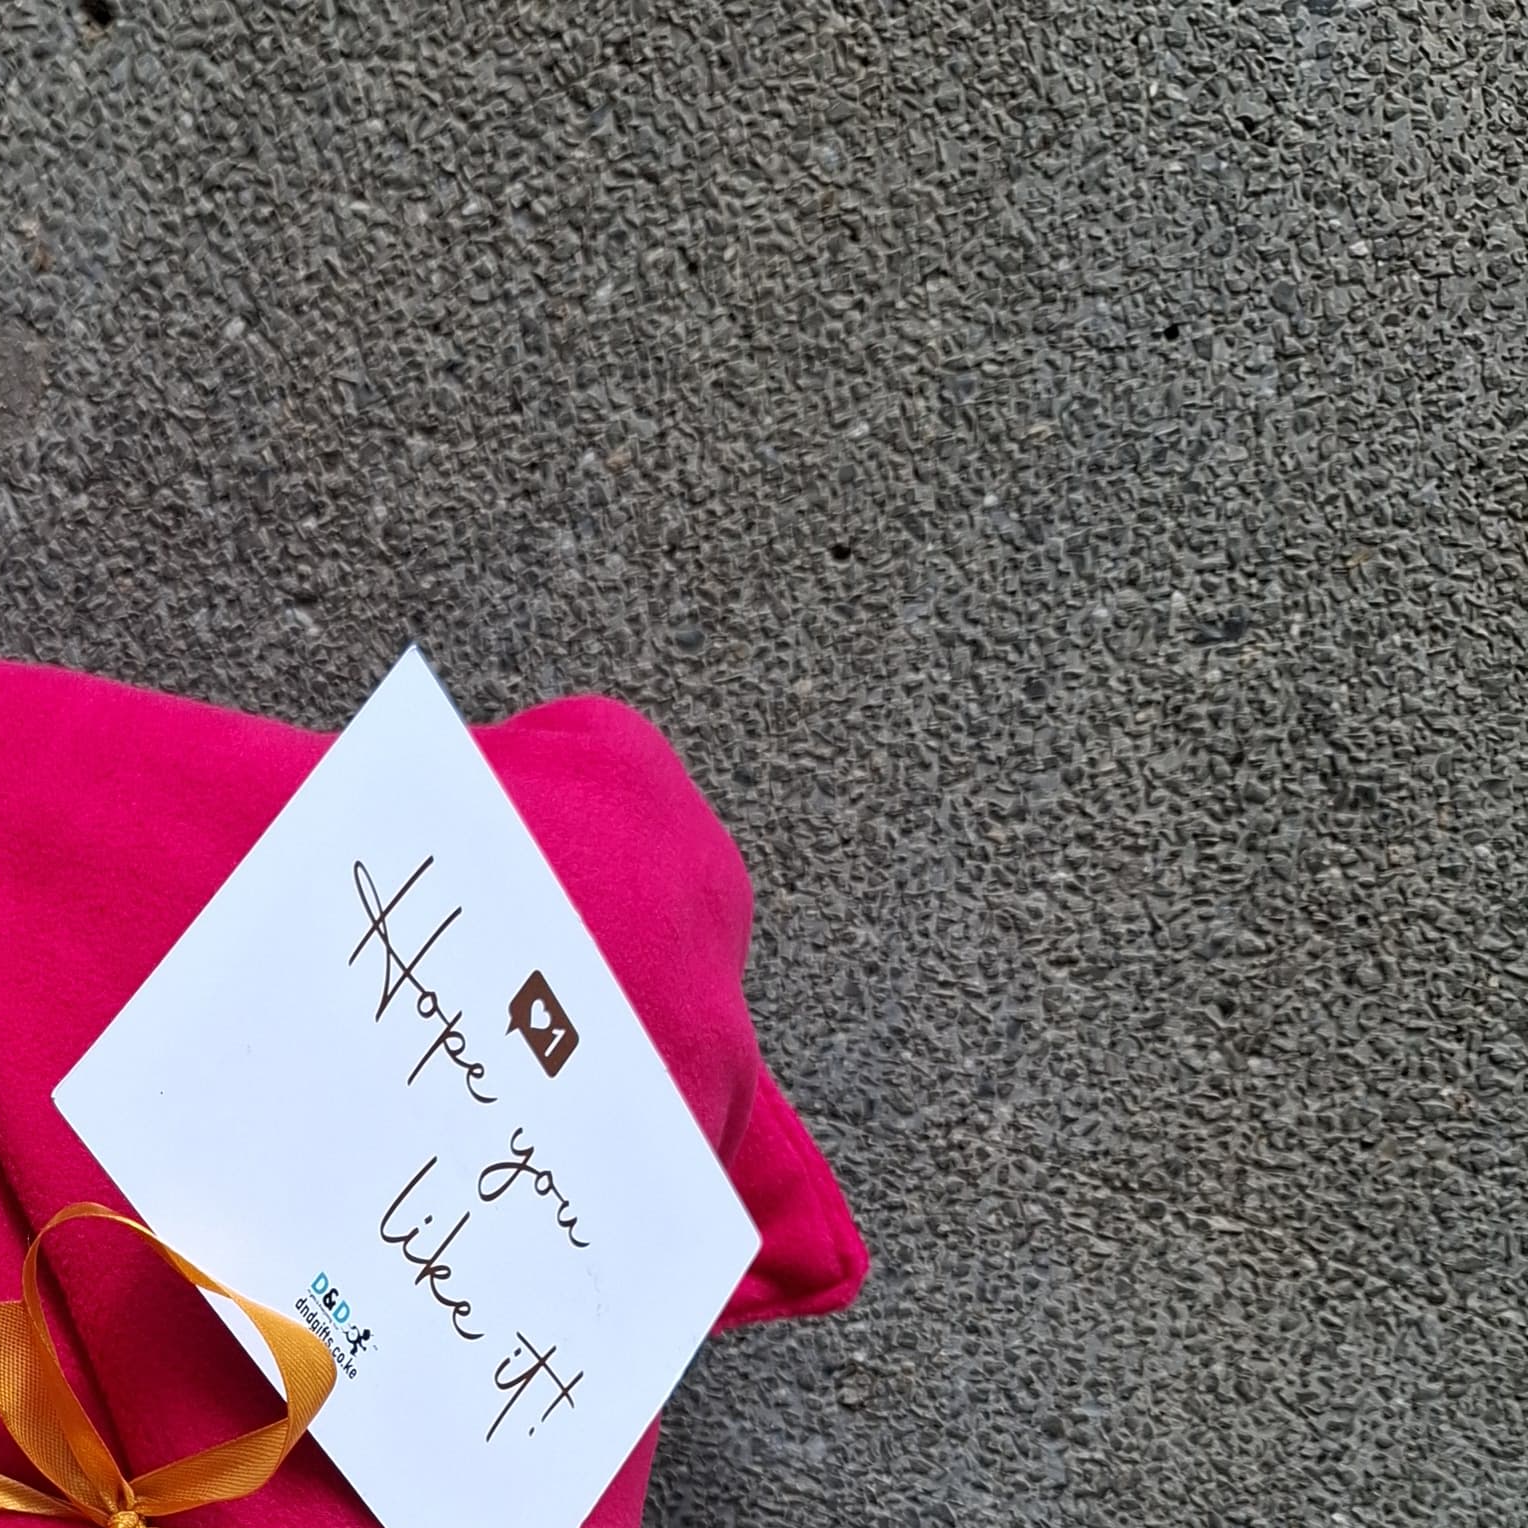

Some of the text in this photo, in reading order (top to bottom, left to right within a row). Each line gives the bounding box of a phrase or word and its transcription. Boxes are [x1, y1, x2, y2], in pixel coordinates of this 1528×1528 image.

[348, 855, 590, 1248] Hope you
[543, 1028, 566, 1057] 1
[379, 1156, 485, 1341] like
[310, 1271, 351, 1324] D&D
[294, 1298, 358, 1380] dndgifts.co.ke
